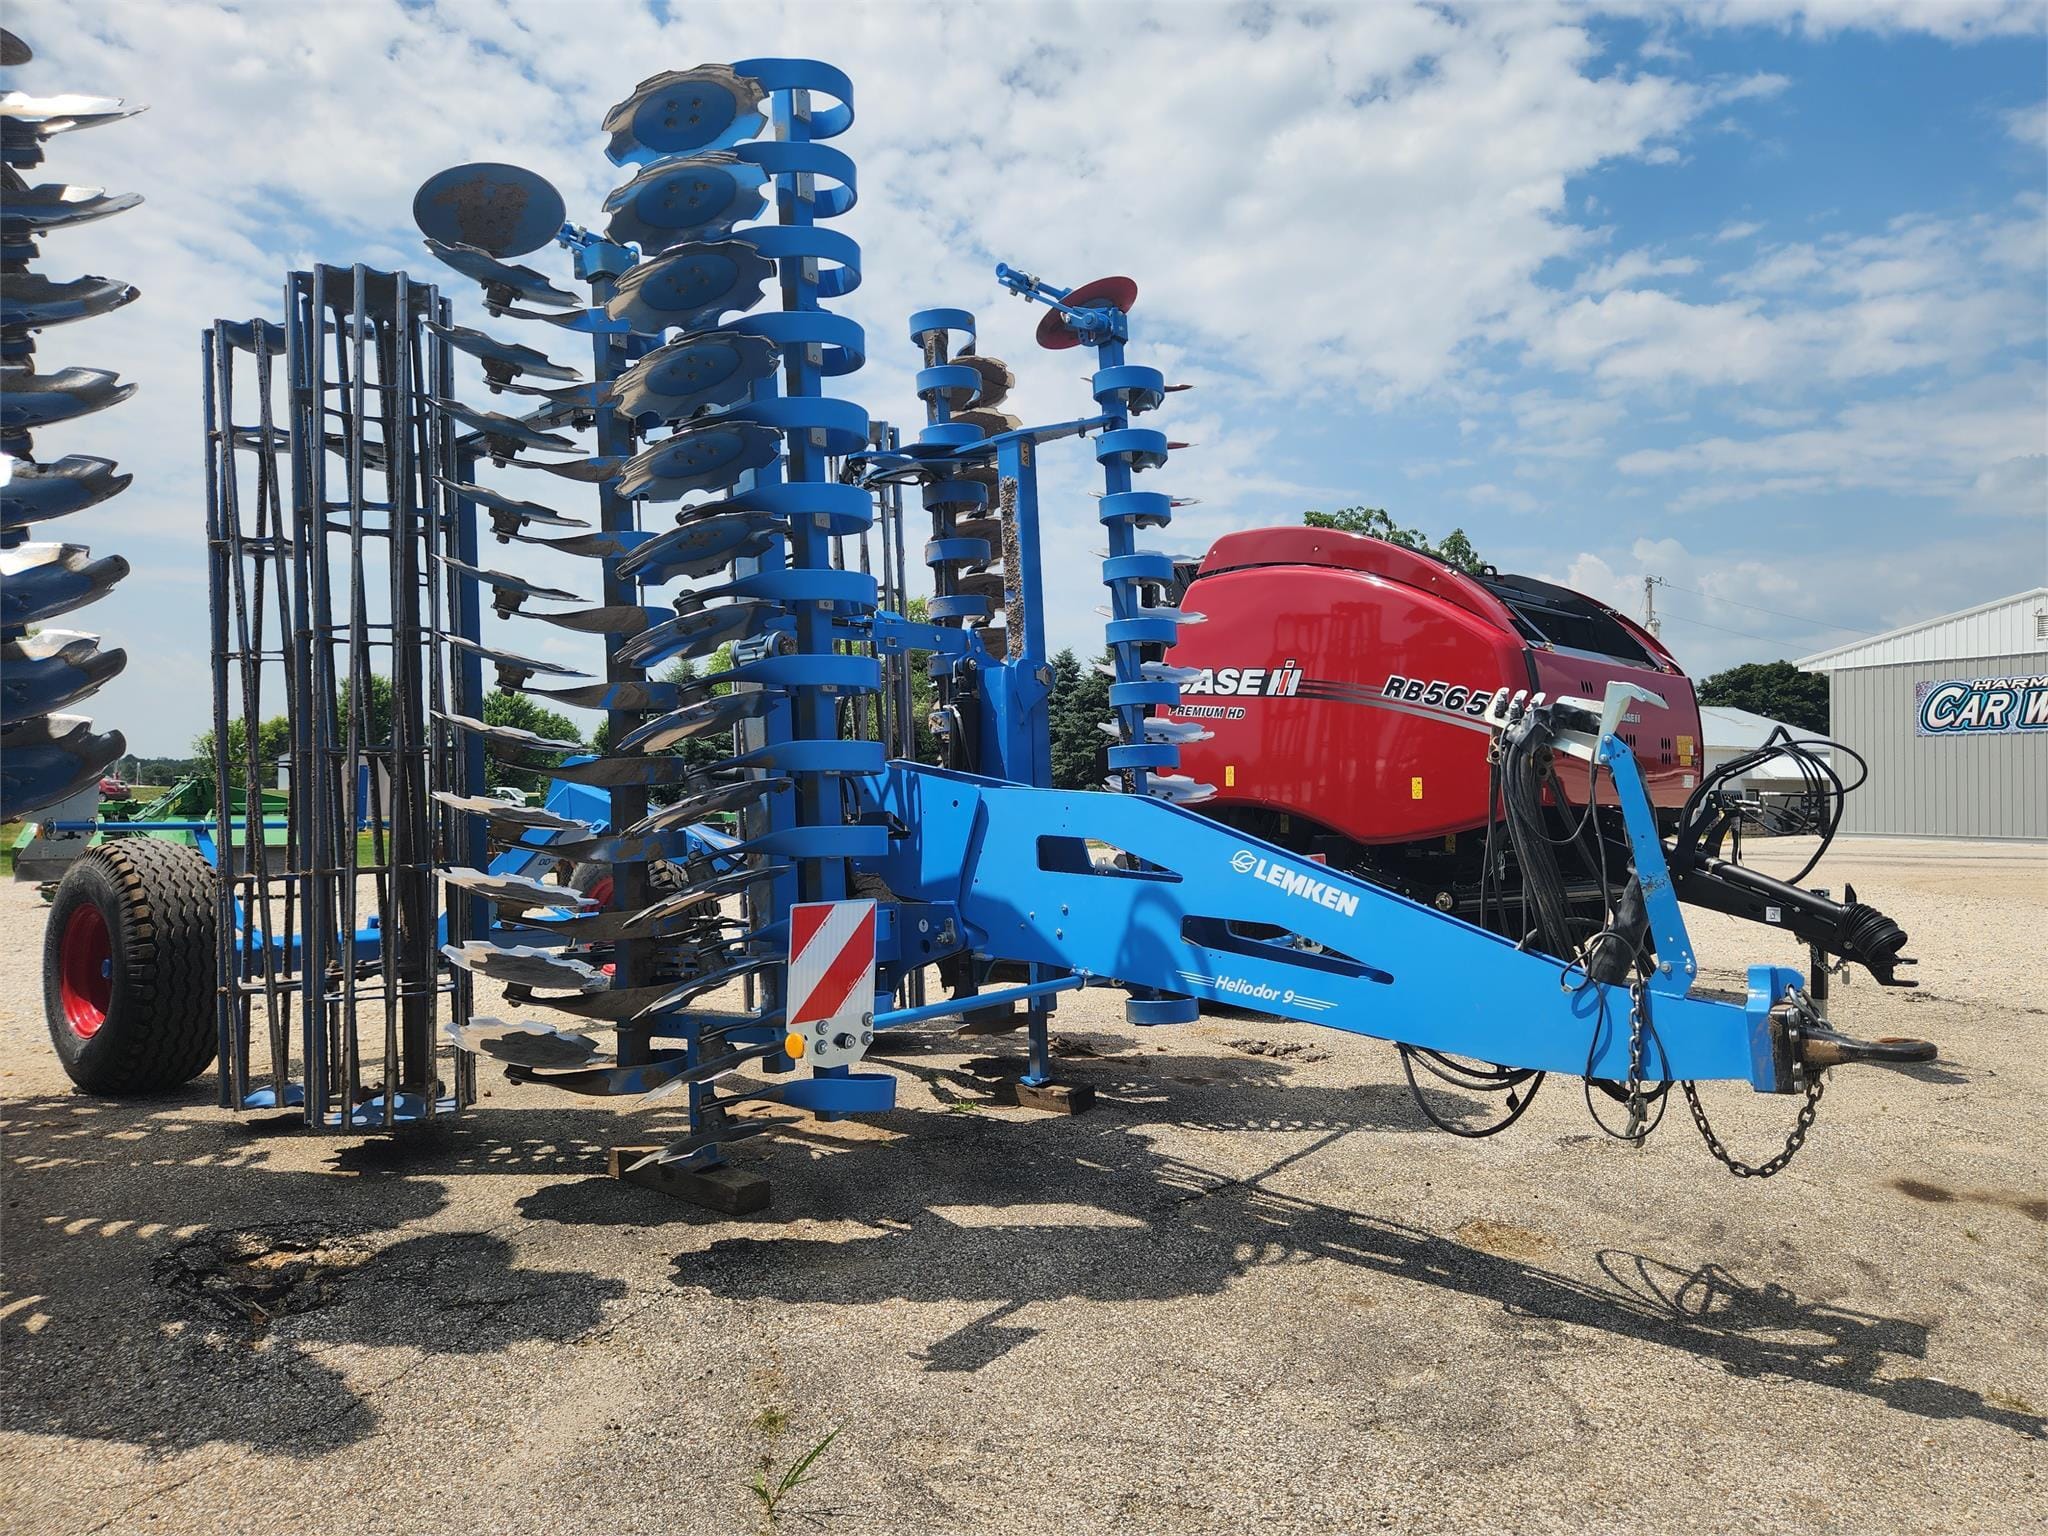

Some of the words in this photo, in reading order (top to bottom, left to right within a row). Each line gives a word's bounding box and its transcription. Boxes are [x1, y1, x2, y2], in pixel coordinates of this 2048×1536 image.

[1226, 707, 1246, 719] HD
[1382, 674, 1492, 716] RB565
[1923, 684, 2012, 730] CAR
[1253, 858, 1360, 917] LEMKEN
[1214, 975, 1280, 1001] Heliodor
[1282, 989, 1295, 1003] 9
